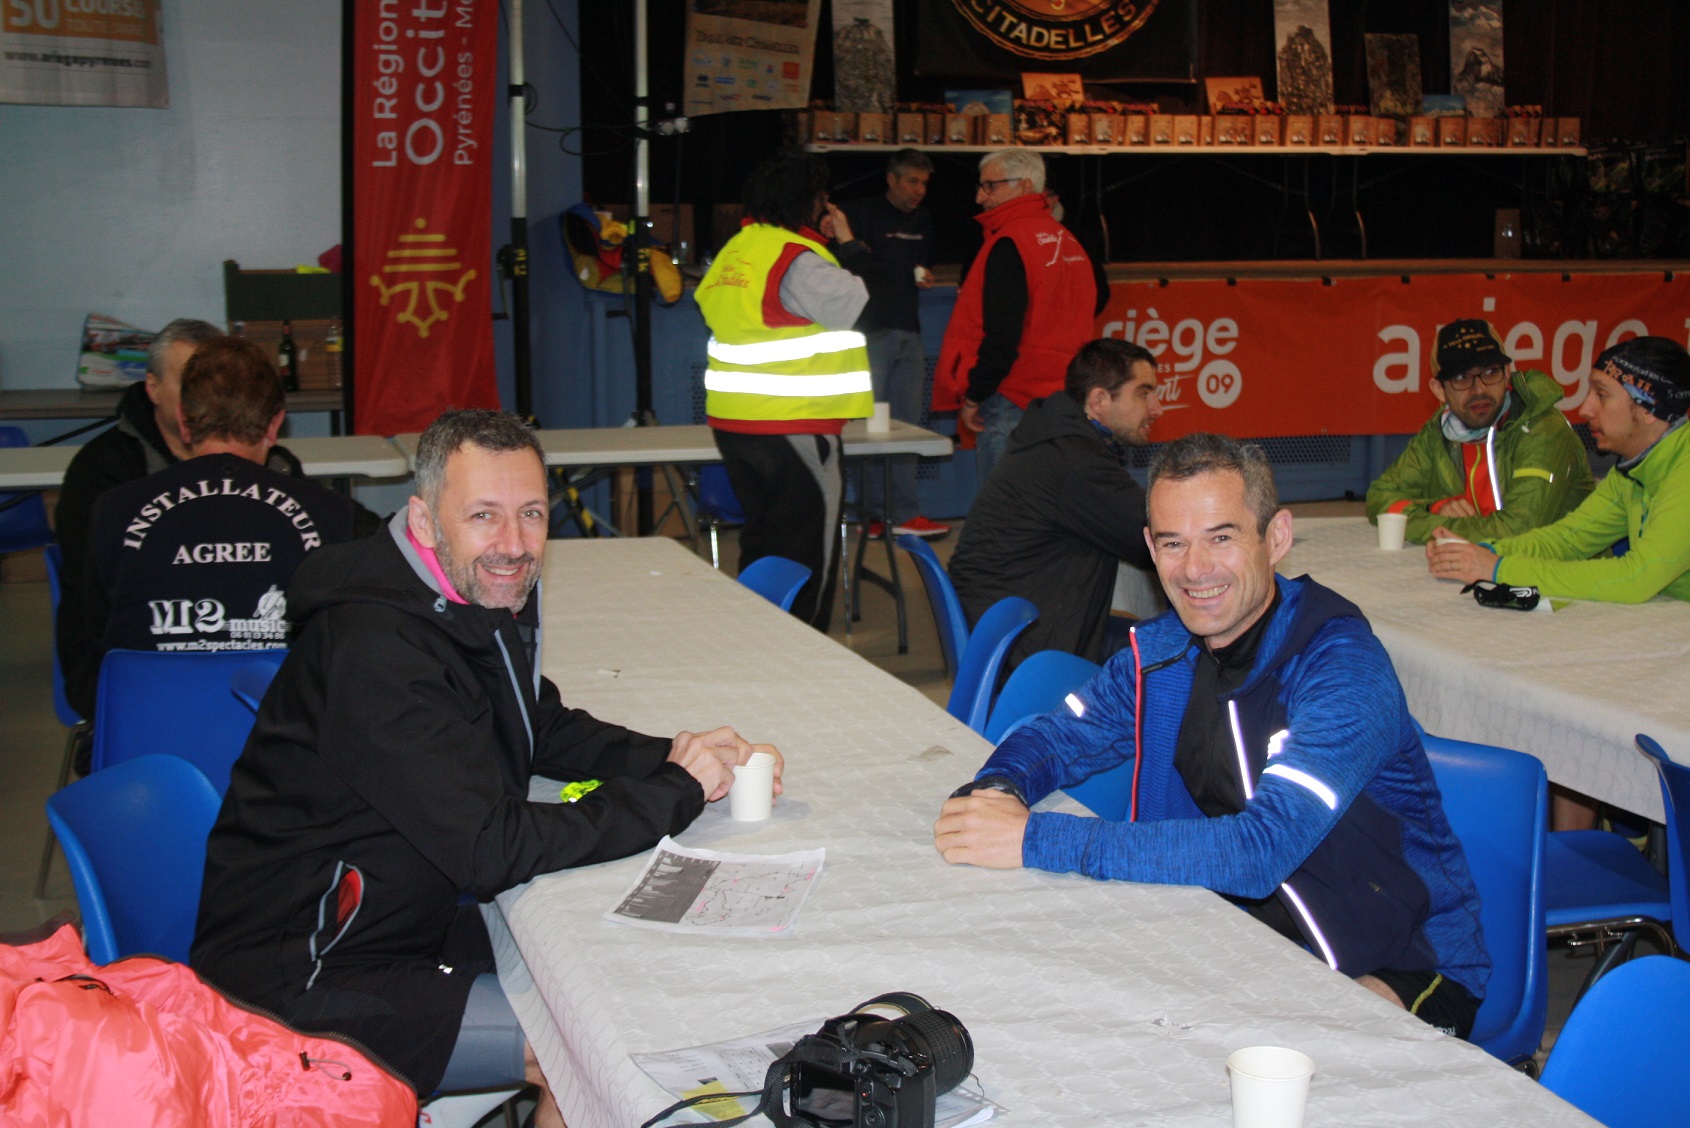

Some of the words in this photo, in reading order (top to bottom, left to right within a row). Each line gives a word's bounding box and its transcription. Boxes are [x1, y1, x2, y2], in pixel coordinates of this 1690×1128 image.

[970, 0, 1137, 50] CITADELLES
[373, 0, 405, 119] Région
[453, 52, 478, 165] Pyrénées
[372, 131, 398, 167] La
[1101, 307, 1240, 373] riège
[1205, 373, 1235, 395] 09
[123, 478, 322, 551] INSTALLATEUR
[172, 541, 272, 565] AGREE
[147, 598, 226, 635] M2
[229, 618, 286, 633] music
[156, 640, 288, 653] www.m2spectacles.com
